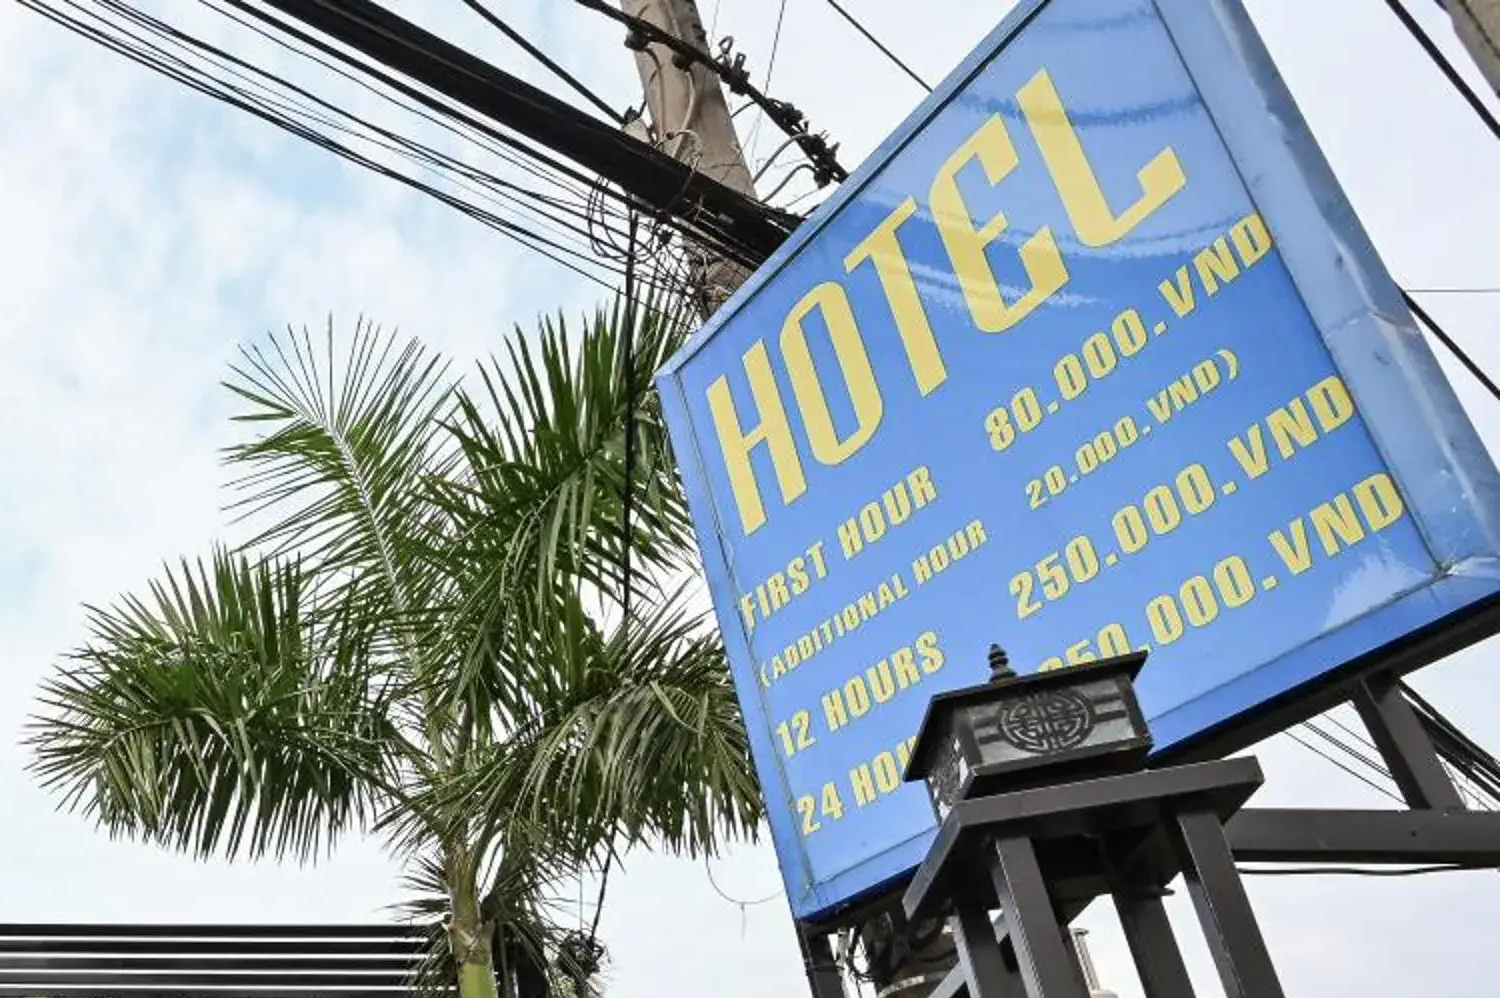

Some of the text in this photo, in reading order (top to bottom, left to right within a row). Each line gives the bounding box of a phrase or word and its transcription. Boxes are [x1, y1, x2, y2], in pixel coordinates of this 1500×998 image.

[706, 66, 1188, 536] HOTEL
[740, 213, 1273, 635] FIRST HOUR 80.000.VND
[760, 349, 1240, 688] (ADDITIONAL HOUR 20.000.VND)
[776, 375, 1355, 759] 12 HOURS 250.000.VND
[797, 782, 845, 835] 24
